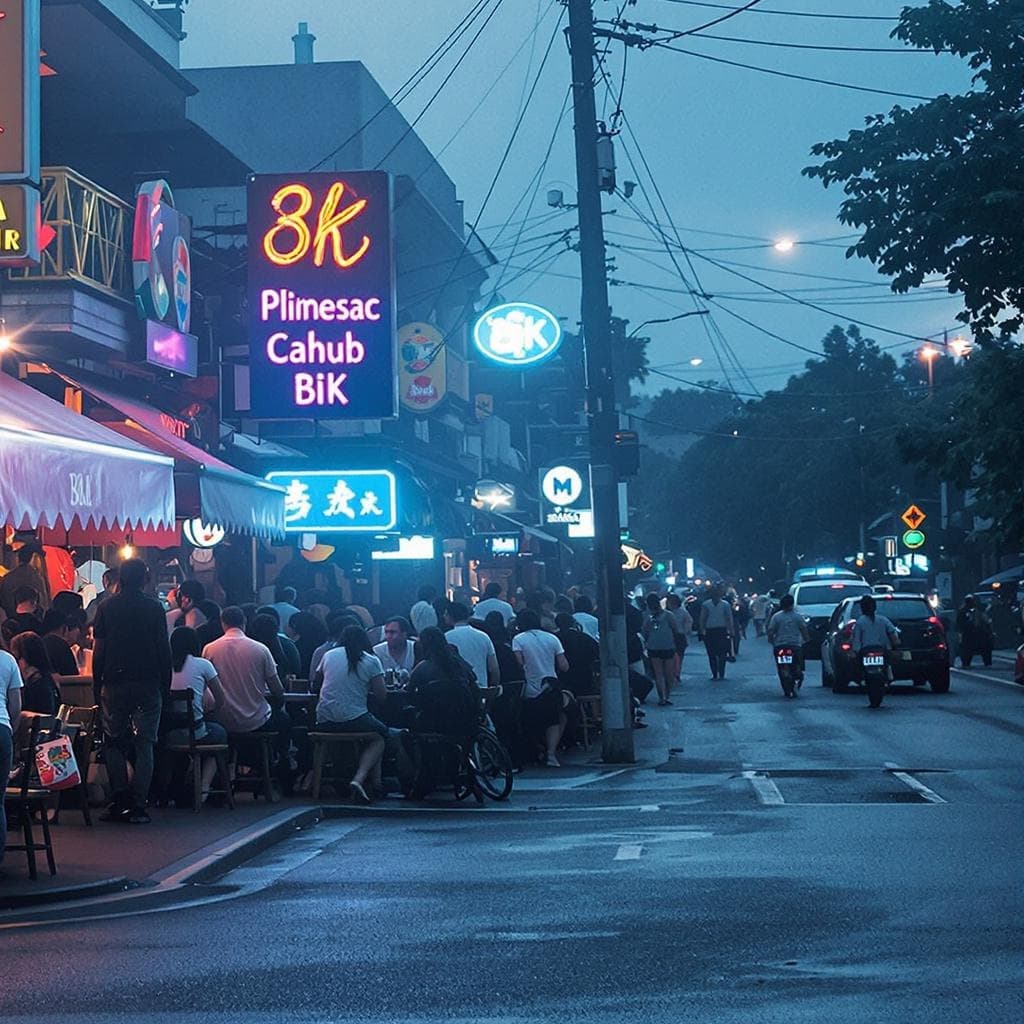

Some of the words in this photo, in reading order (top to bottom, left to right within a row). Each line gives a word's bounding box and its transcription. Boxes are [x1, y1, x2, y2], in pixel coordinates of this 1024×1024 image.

[261, 289, 381, 321] Plimesac
[267, 330, 365, 364] Cahub
[553, 477, 572, 496] M
